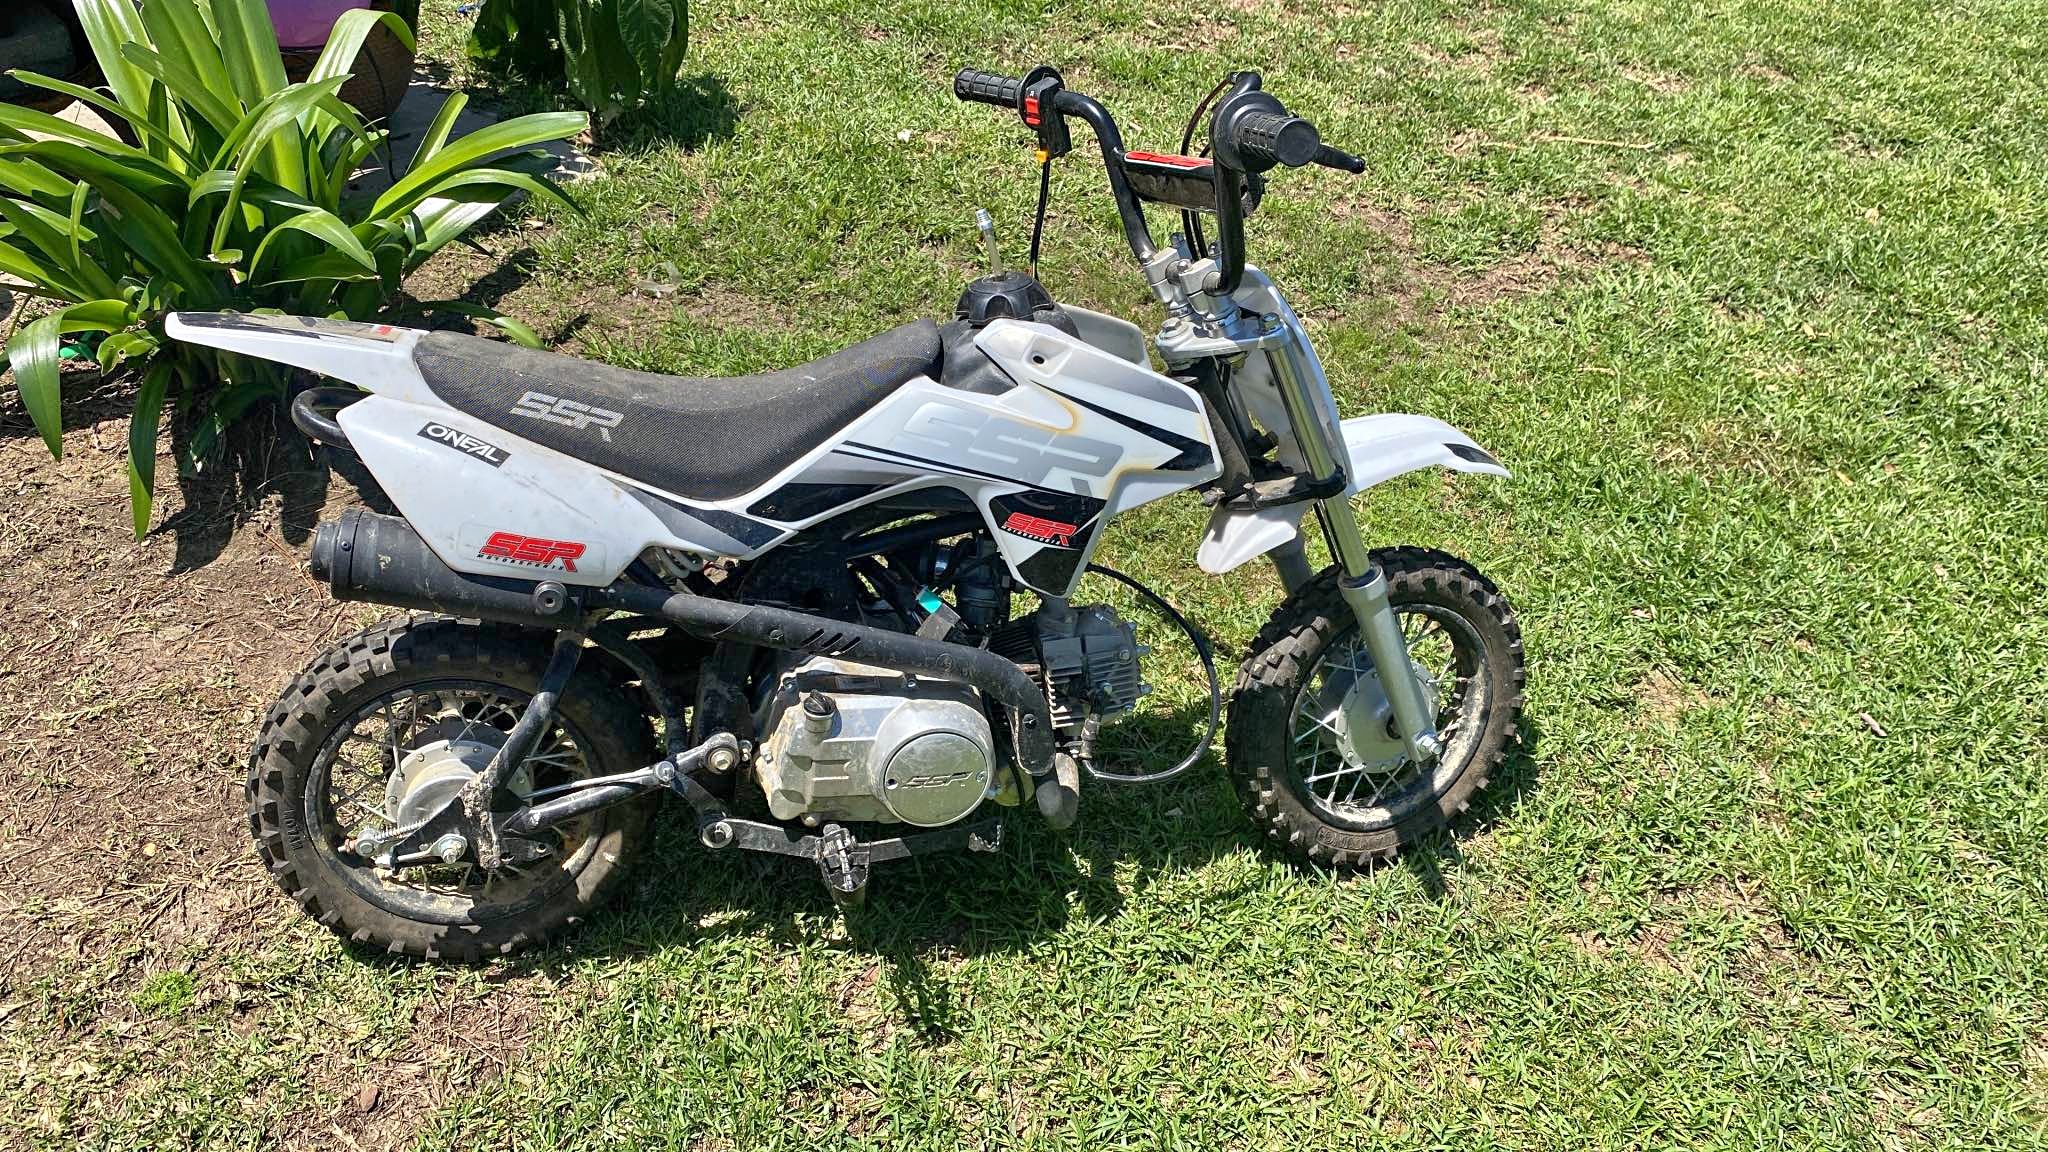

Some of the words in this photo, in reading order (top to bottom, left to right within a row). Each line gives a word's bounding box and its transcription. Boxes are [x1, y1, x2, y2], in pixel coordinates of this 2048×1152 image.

[508, 391, 624, 442] SSR
[888, 401, 1124, 497] SSR
[480, 531, 587, 572] SSR
[1004, 512, 1077, 546] SSR
